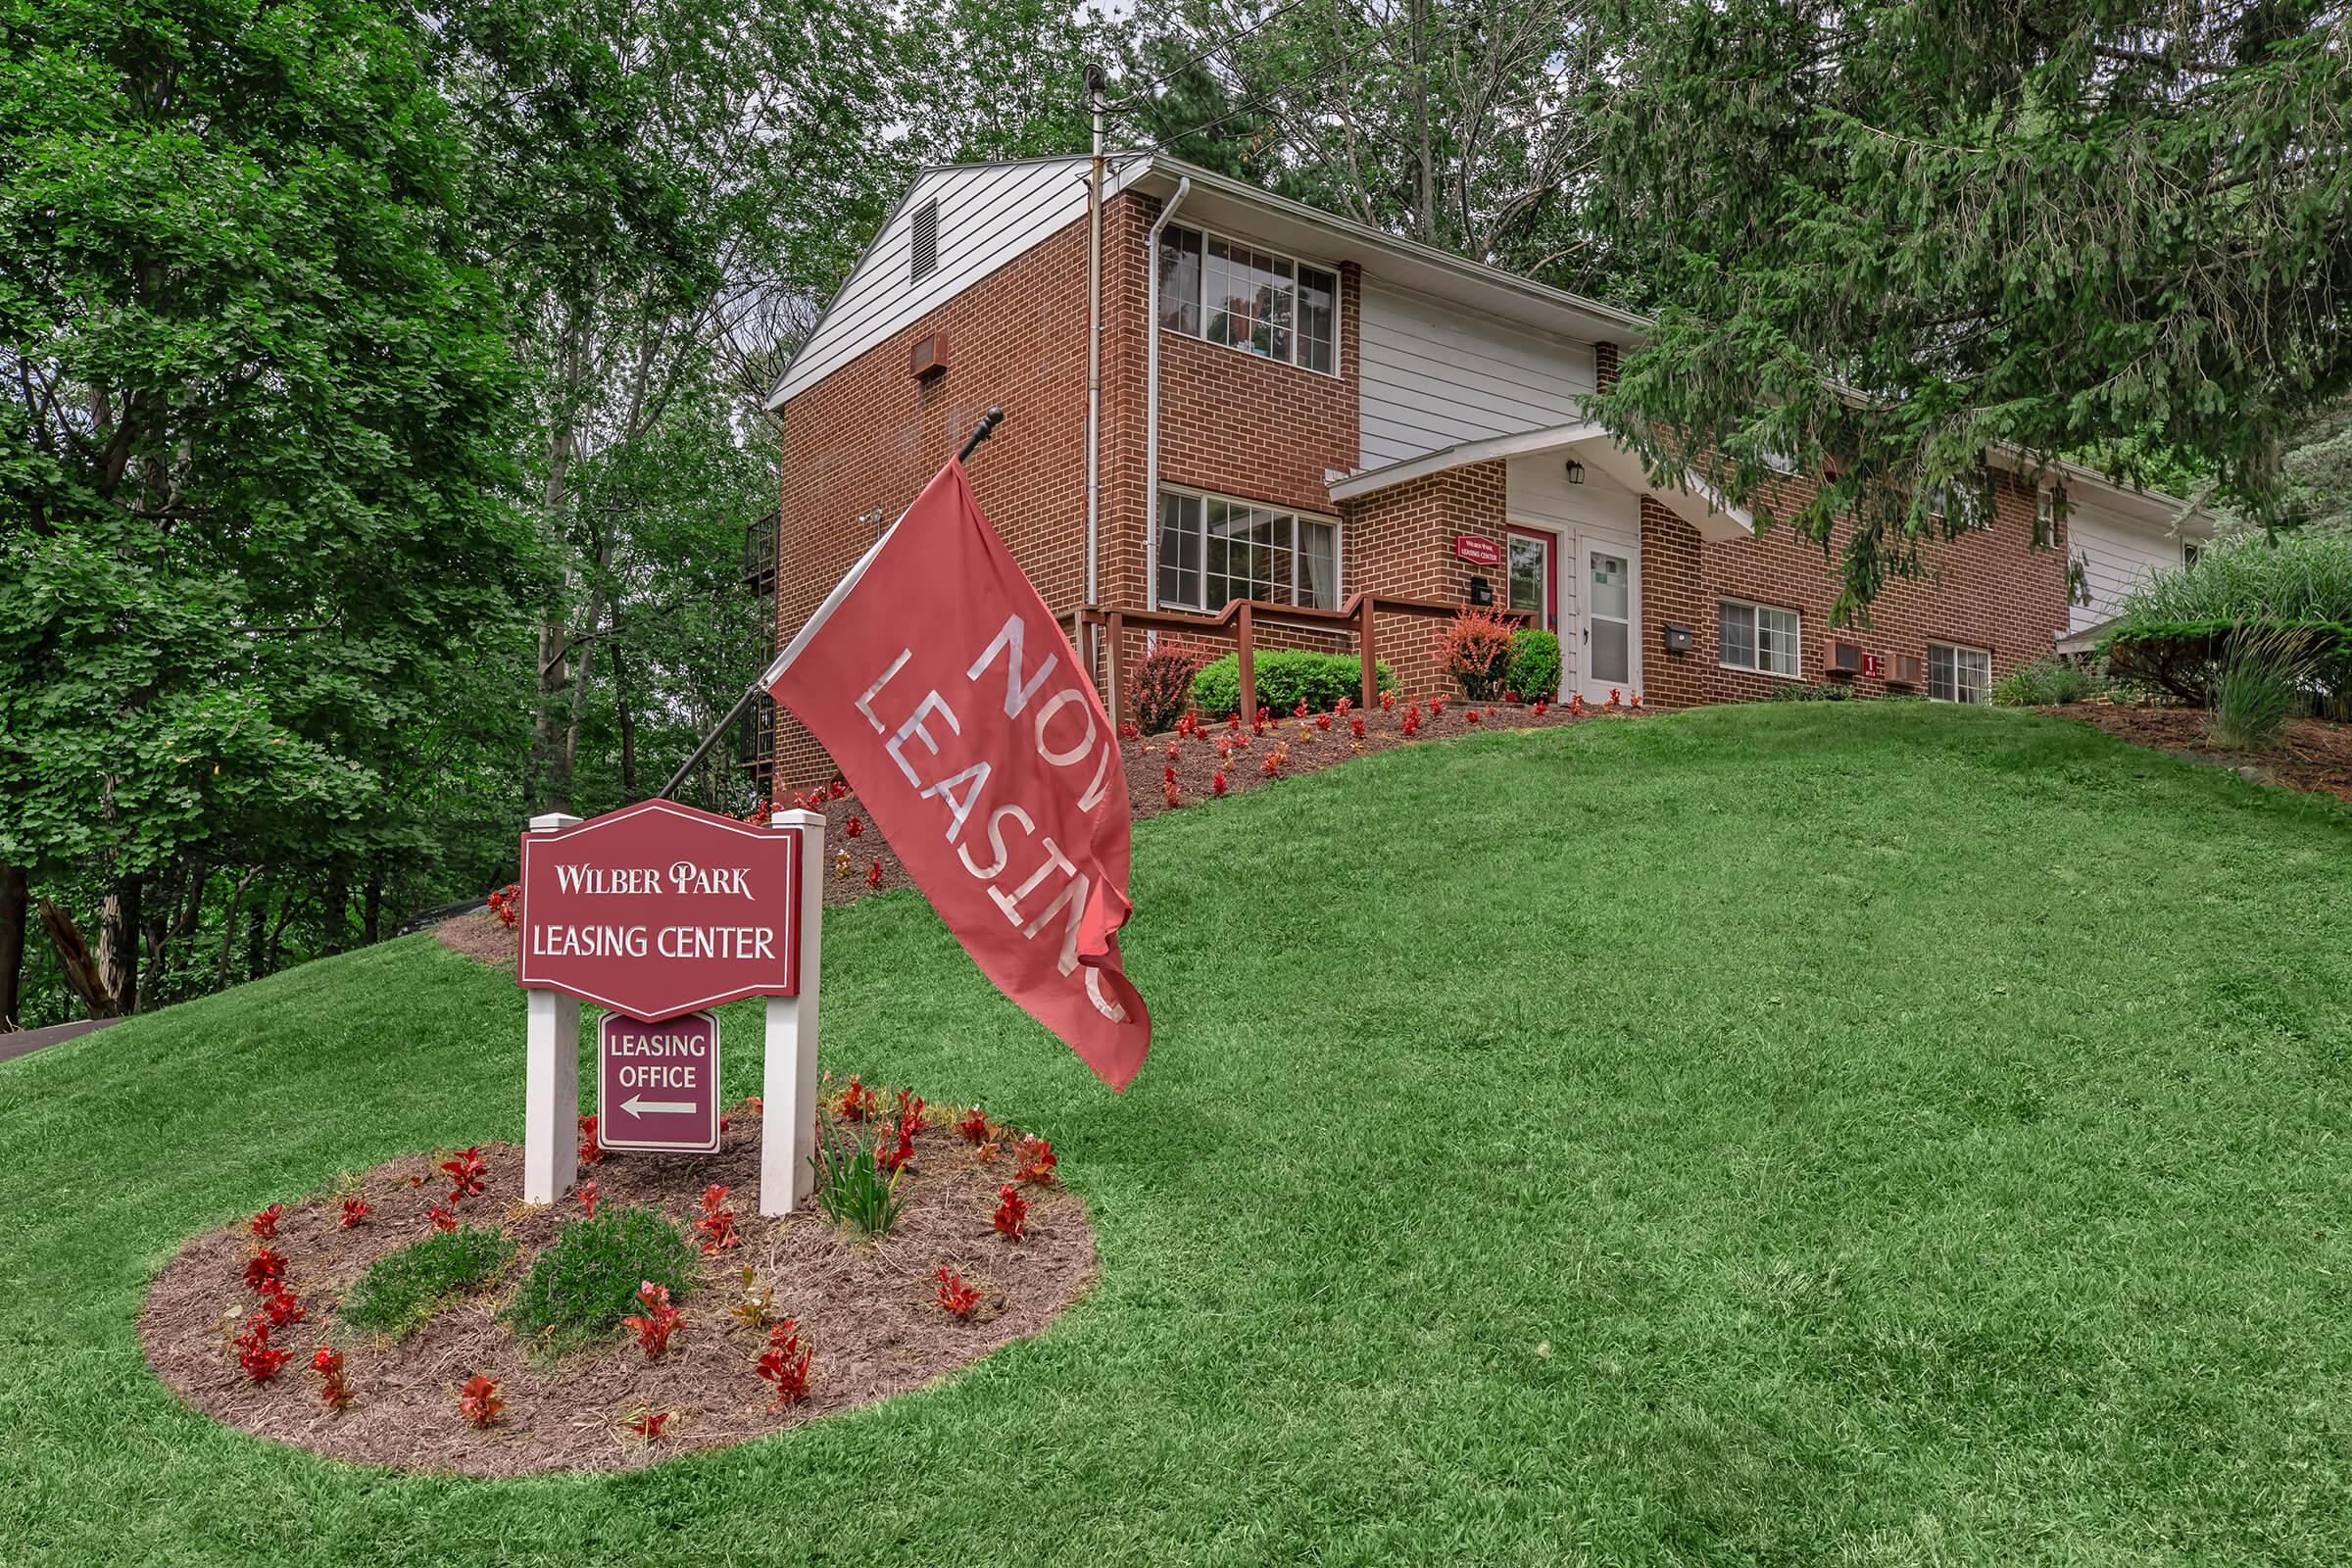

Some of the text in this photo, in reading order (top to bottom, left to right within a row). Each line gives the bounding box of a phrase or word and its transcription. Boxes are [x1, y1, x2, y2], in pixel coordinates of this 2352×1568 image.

[1461, 548, 1497, 561] LEASING CENTER
[1868, 657, 1872, 670] 1
[555, 860, 756, 901] WILBER PARK
[533, 924, 775, 959] LEASING CENTER
[611, 1034, 706, 1057] LEASING
[618, 1065, 697, 1089] OFFICE
